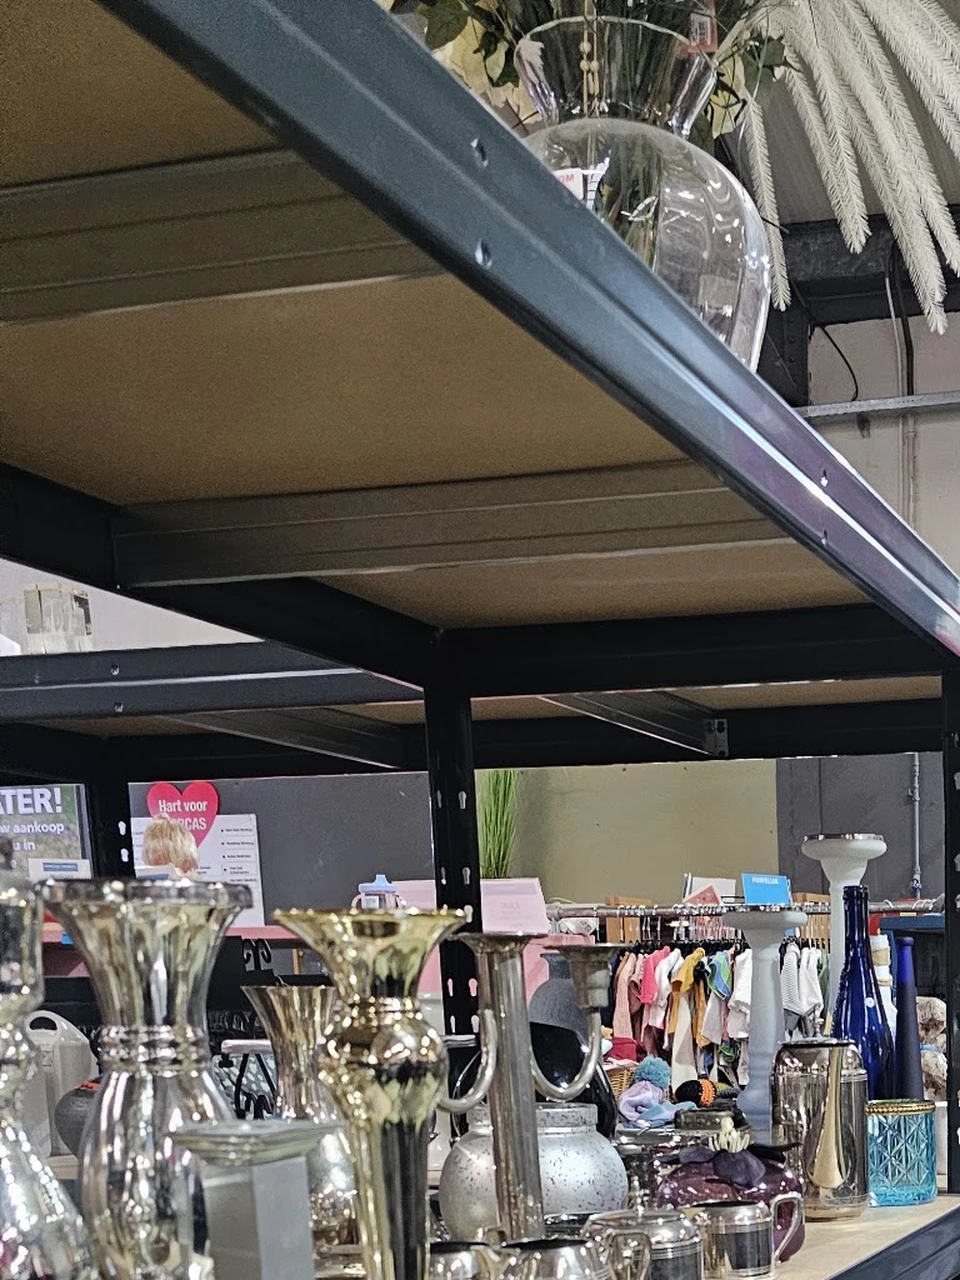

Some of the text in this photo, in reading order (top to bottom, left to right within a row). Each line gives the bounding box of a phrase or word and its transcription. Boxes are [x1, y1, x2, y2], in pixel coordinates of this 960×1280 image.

[158, 799, 208, 812] Hart voor
[13, 821, 65, 835] aankoop
